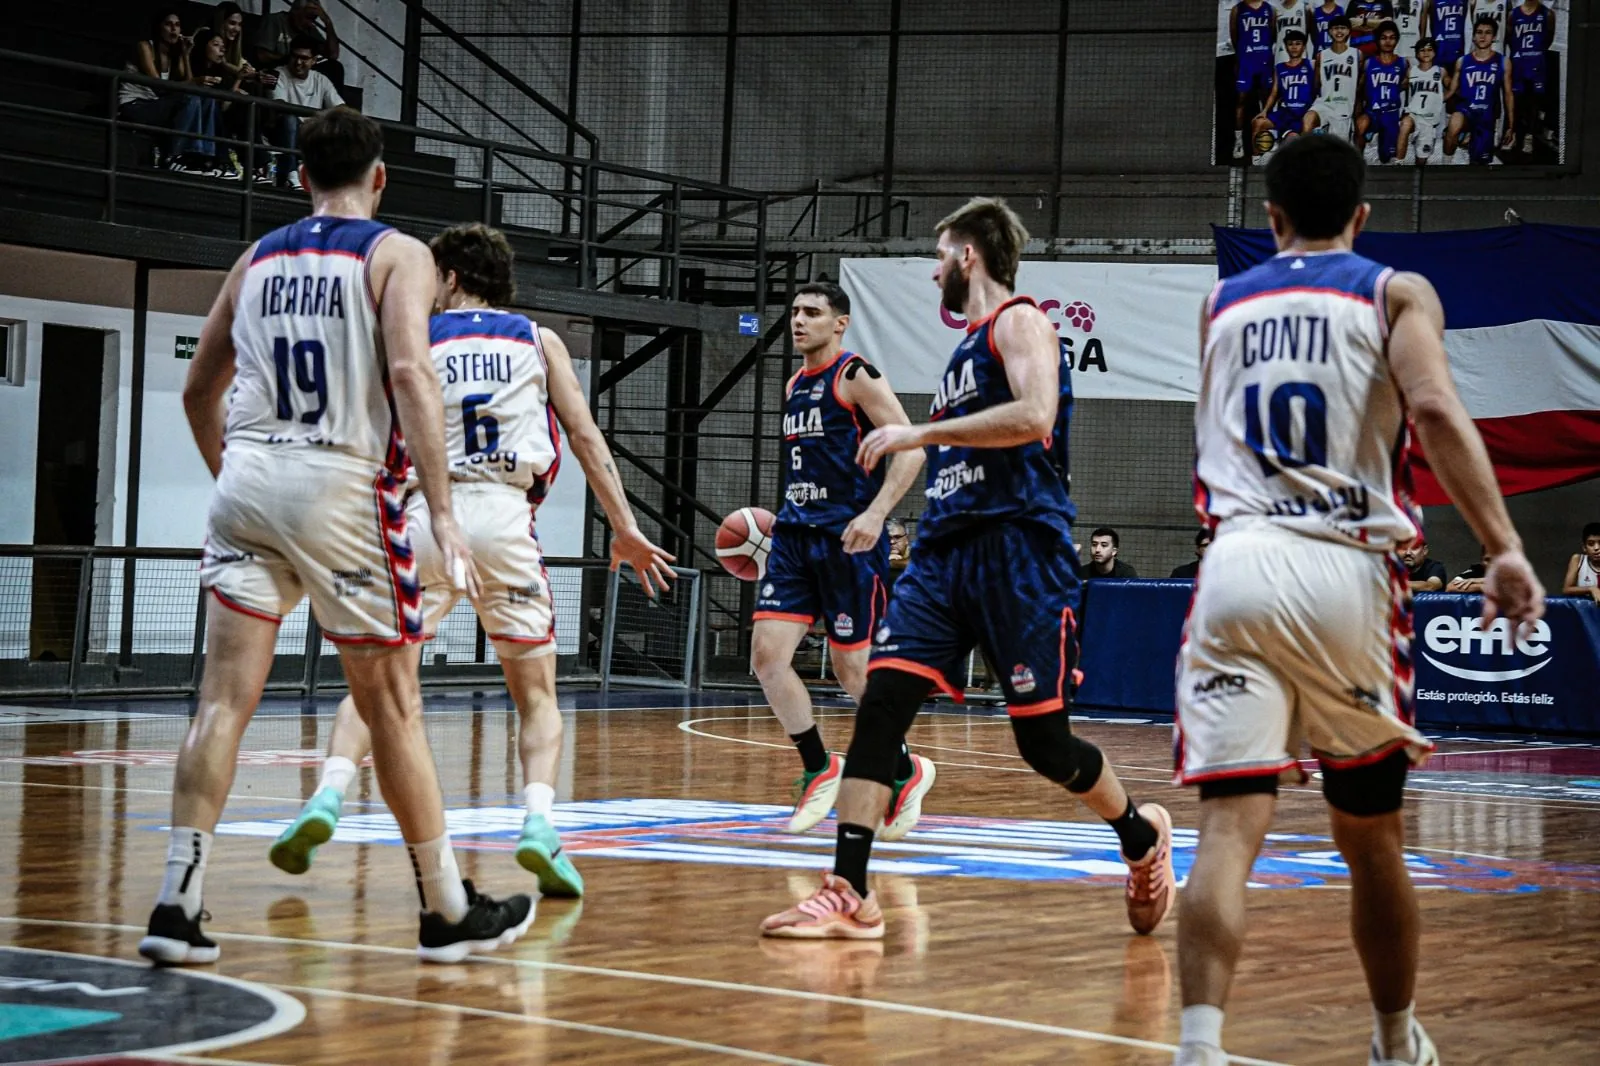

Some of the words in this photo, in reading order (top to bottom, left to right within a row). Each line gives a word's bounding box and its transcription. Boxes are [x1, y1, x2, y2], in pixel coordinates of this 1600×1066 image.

[1402, 17, 1408, 28] 5
[1445, 17, 1456, 31] 15
[1515, 23, 1542, 38] VILLA
[1253, 29, 1260, 43] 9
[1522, 35, 1534, 48] 12
[1324, 64, 1352, 82] VILLA
[1371, 72, 1400, 88] VILLA
[1466, 71, 1496, 88] VILLA
[1281, 75, 1308, 90] VILLA
[1410, 80, 1439, 97] VILLA
[1288, 86, 1298, 100] 11
[1475, 85, 1487, 100] 13
[1420, 94, 1428, 109] 7
[261, 275, 345, 319] IBARRA
[1242, 315, 1330, 369] CONTI
[446, 352, 512, 384] STEHLI
[273, 336, 328, 425] 19
[461, 393, 499, 457] 6
[1244, 381, 1328, 478] 10
[791, 446, 802, 470] 6
[1424, 614, 1552, 657] eme
[1416, 688, 1446, 701] Estás
[1447, 690, 1499, 705] protegido.
[1501, 691, 1530, 704] Estás
[1531, 693, 1555, 705] feliz
